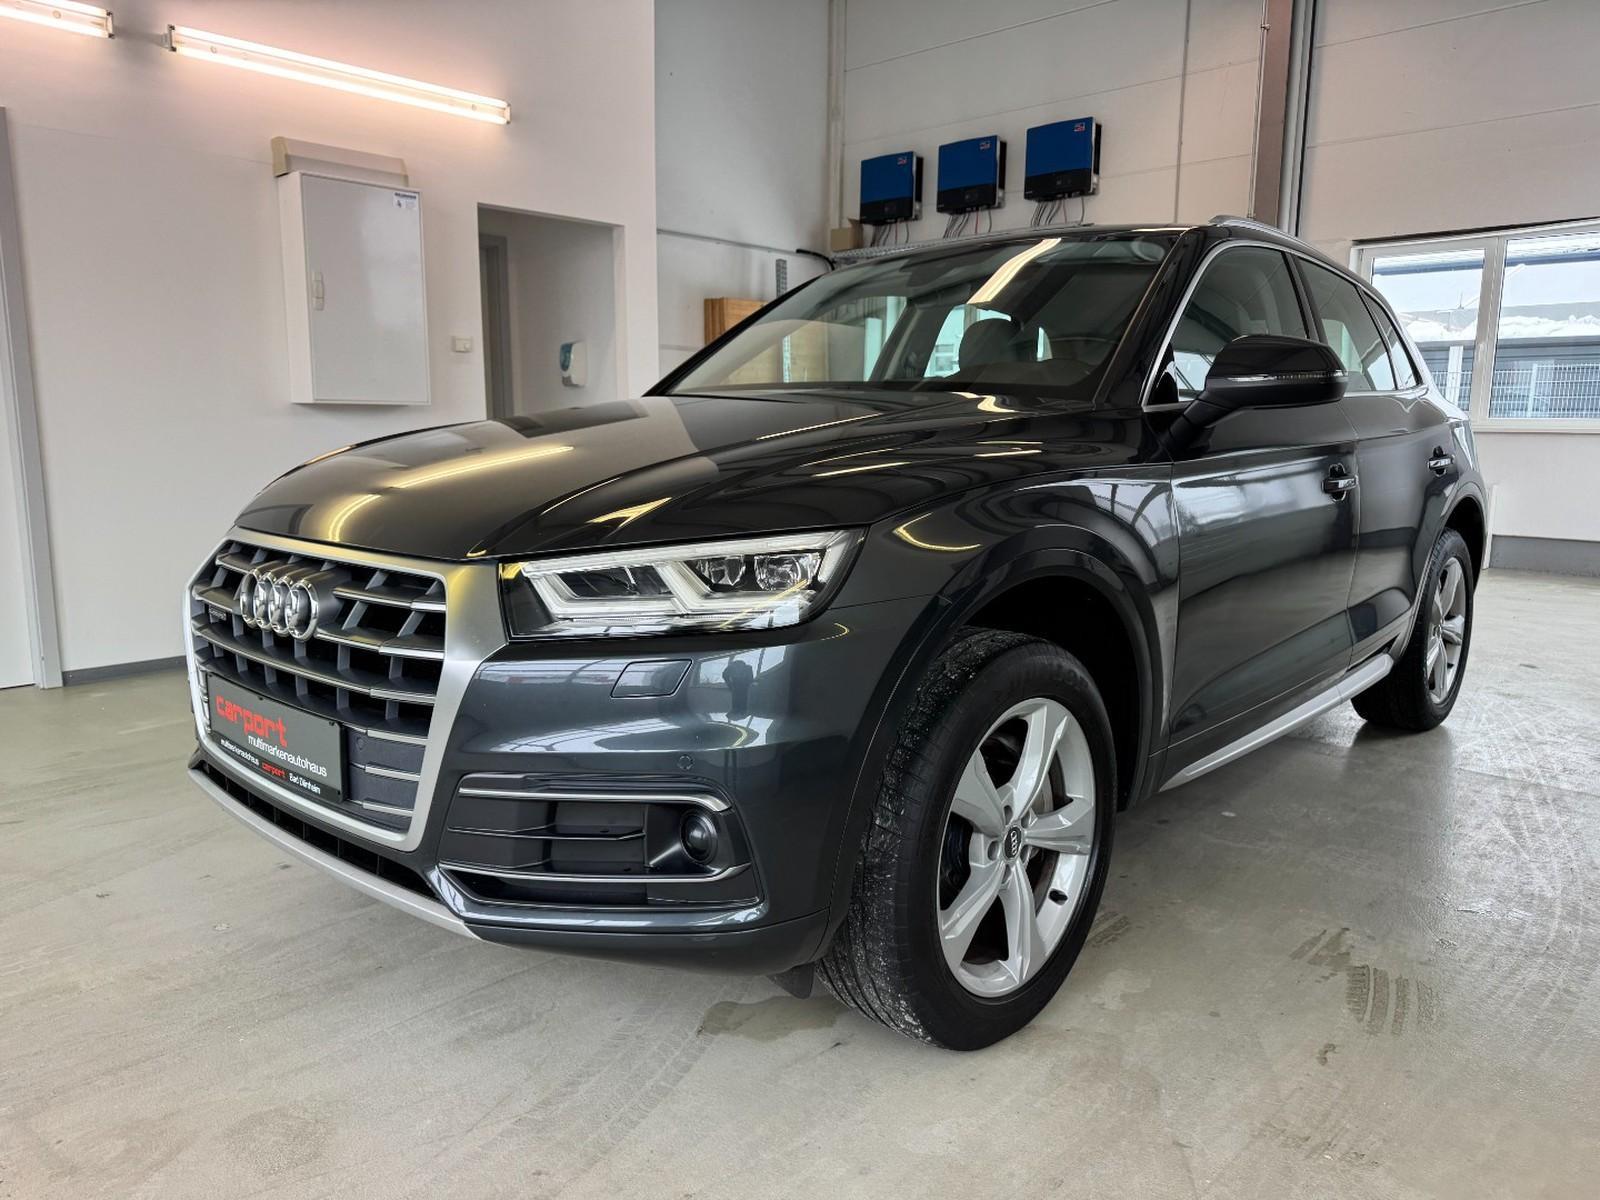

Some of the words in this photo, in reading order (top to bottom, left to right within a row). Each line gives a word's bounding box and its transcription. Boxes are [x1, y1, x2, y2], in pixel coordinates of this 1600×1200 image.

[215, 695, 288, 748] carport
[248, 735, 327, 777] multimarkenautohaus
[261, 762, 286, 779] carport
